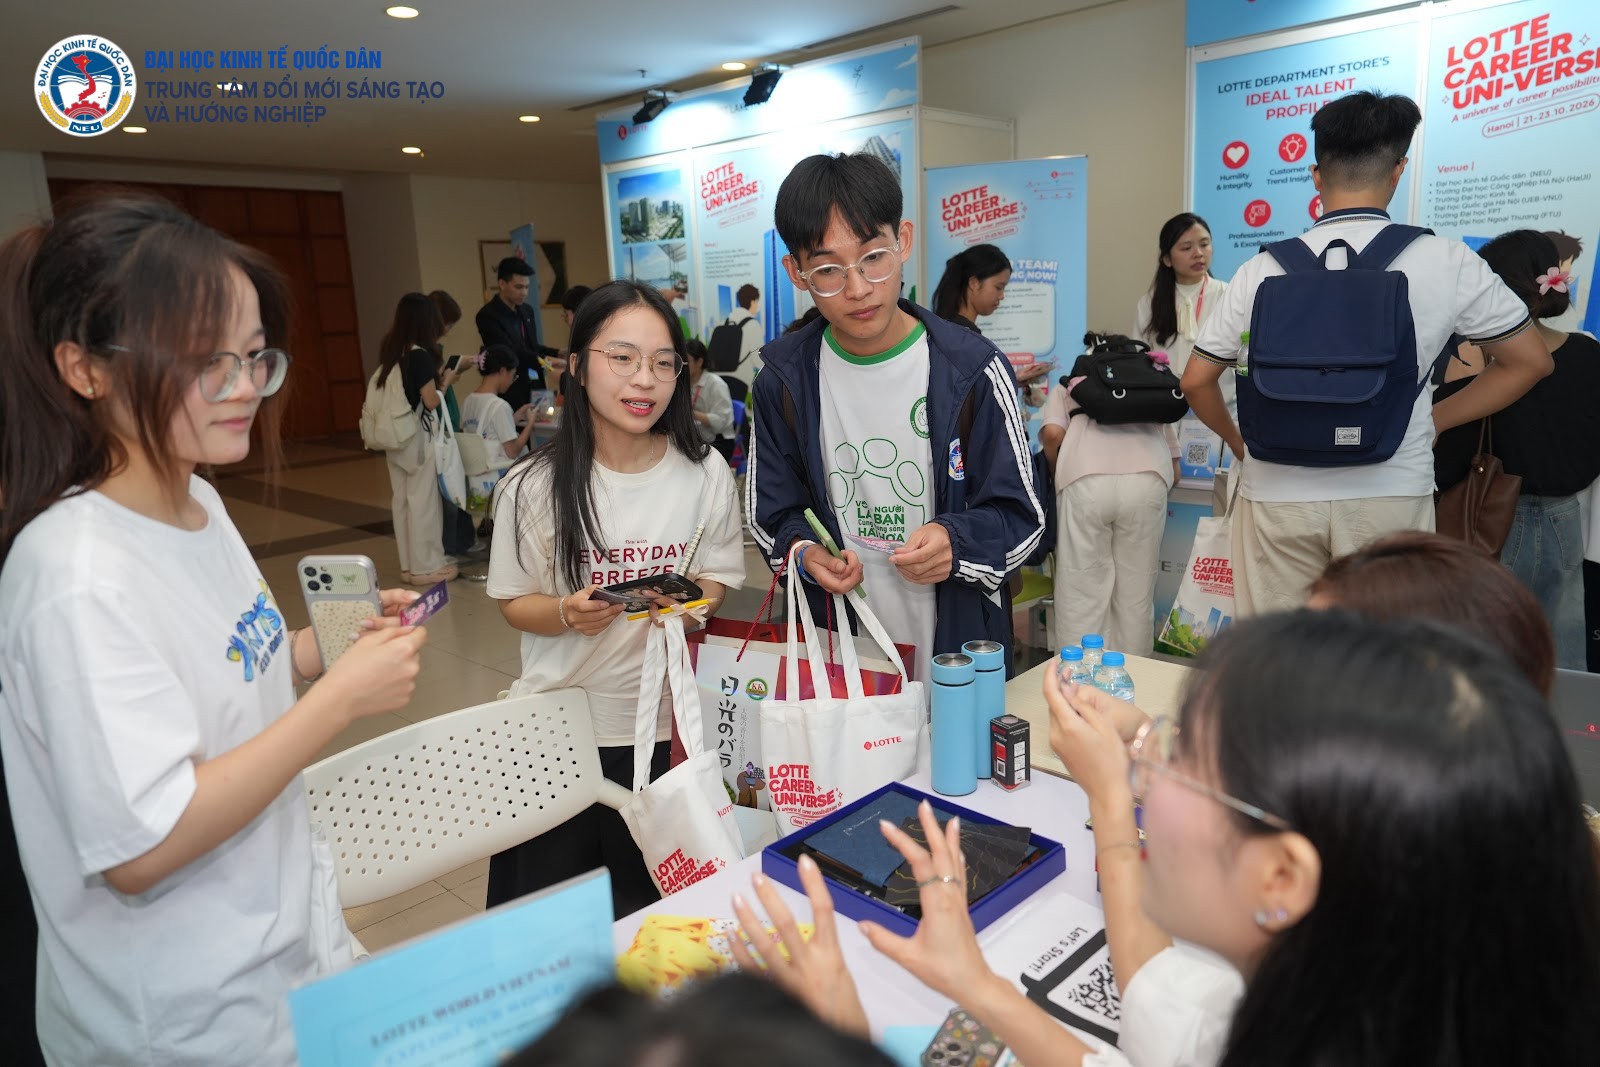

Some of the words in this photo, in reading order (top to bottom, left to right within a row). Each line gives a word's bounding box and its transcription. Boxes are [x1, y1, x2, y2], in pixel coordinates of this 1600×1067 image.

[1448, 13, 1550, 68] LOTTE
[1444, 32, 1572, 89] CAREER
[1218, 80, 1251, 93] LOTTE
[1255, 66, 1336, 88] DEPARTMENT
[1338, 56, 1390, 74] STORE'S
[1246, 89, 1290, 106] IDEAL
[1295, 78, 1356, 98] TALENT
[1462, 104, 1499, 120] universe
[1503, 98, 1514, 108] of
[1517, 90, 1548, 105] career
[1487, 122, 1514, 133] Hanoi
[701, 162, 734, 186] LOTTE
[1270, 167, 1305, 176] Customer
[1438, 164, 1469, 173] Venue
[1530, 170, 1552, 178] (NEU)
[1220, 173, 1249, 181] Humility
[1290, 175, 1313, 184] Insigh
[702, 173, 743, 199] CAREER
[1223, 182, 1252, 190] Integrity
[706, 181, 758, 210] UNI-VERSE
[942, 185, 988, 210] LOTTE
[942, 196, 999, 221] CAREER
[948, 202, 1018, 232] UNI-VERSE
[1228, 230, 1284, 240] Professionalism
[1018, 260, 1058, 271] TEAM!
[1027, 271, 1056, 280] NOW!
[875, 504, 904, 513] NGƯỜI
[874, 514, 904, 525] BẠN
[580, 542, 687, 564] EVERYDAY
[1193, 564, 1232, 576] CAREER
[1195, 556, 1229, 568] LOTTE
[1193, 572, 1234, 584] UNI-VER
[874, 736, 902, 748] LOTTE
[769, 764, 809, 779] LOTTE
[769, 778, 814, 794] CAREER
[774, 790, 836, 808] UNI-VERSE
[653, 848, 685, 881] LOTTE
[660, 857, 697, 893] CAREER
[1060, 927, 1088, 947] Let's
[1029, 947, 1064, 973] Start!
